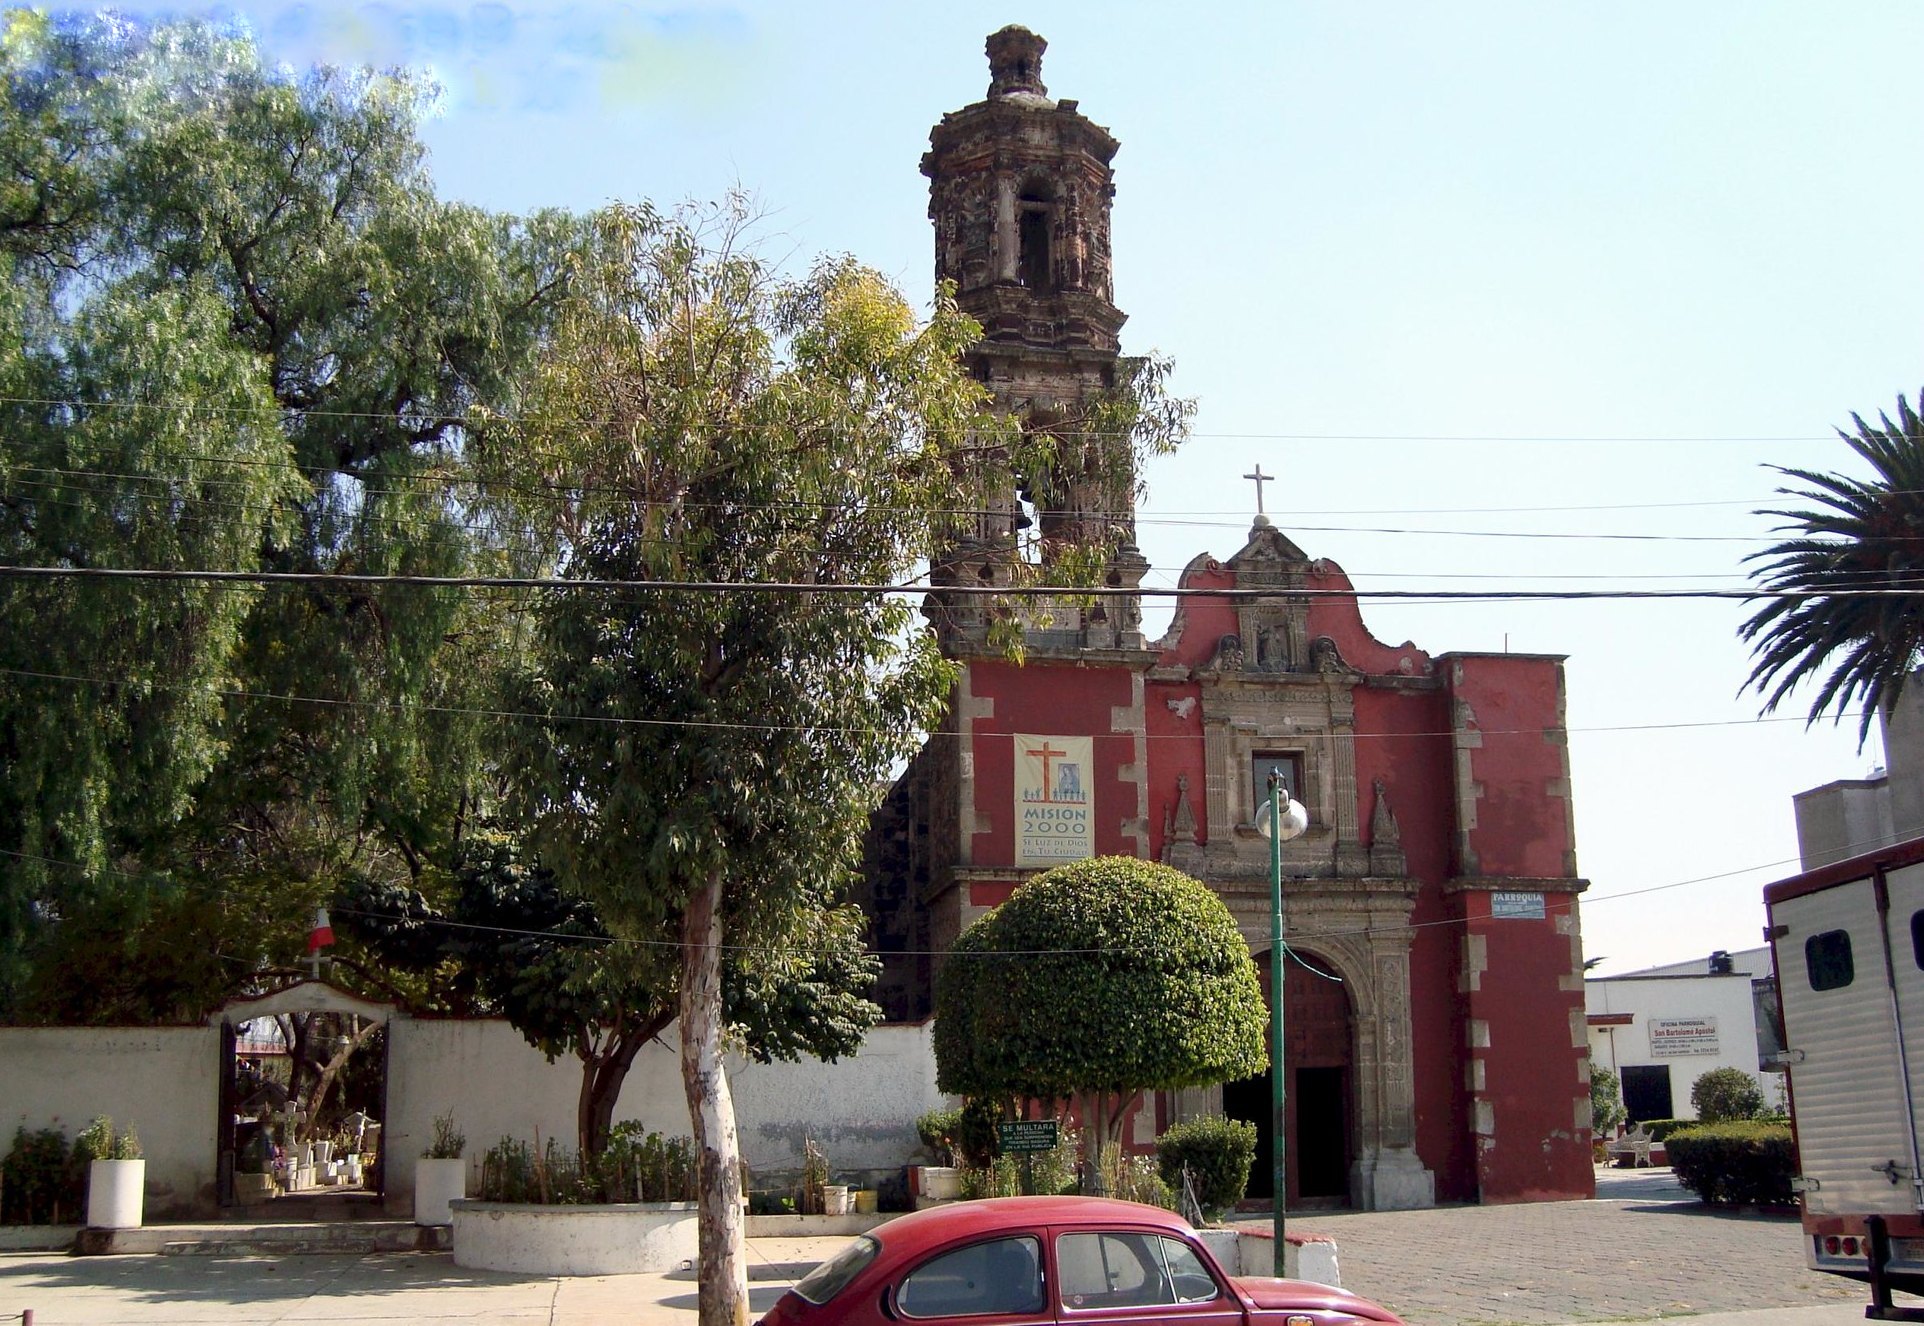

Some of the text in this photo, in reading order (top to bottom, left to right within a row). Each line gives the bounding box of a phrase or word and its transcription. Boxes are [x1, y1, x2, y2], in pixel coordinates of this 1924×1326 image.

[1024, 806, 1086, 820] MISIÓN
[1024, 820, 1085, 834] 2000
[1054, 848, 1088, 856] CIUDAD
[1493, 893, 1542, 902] PARROQUIA
